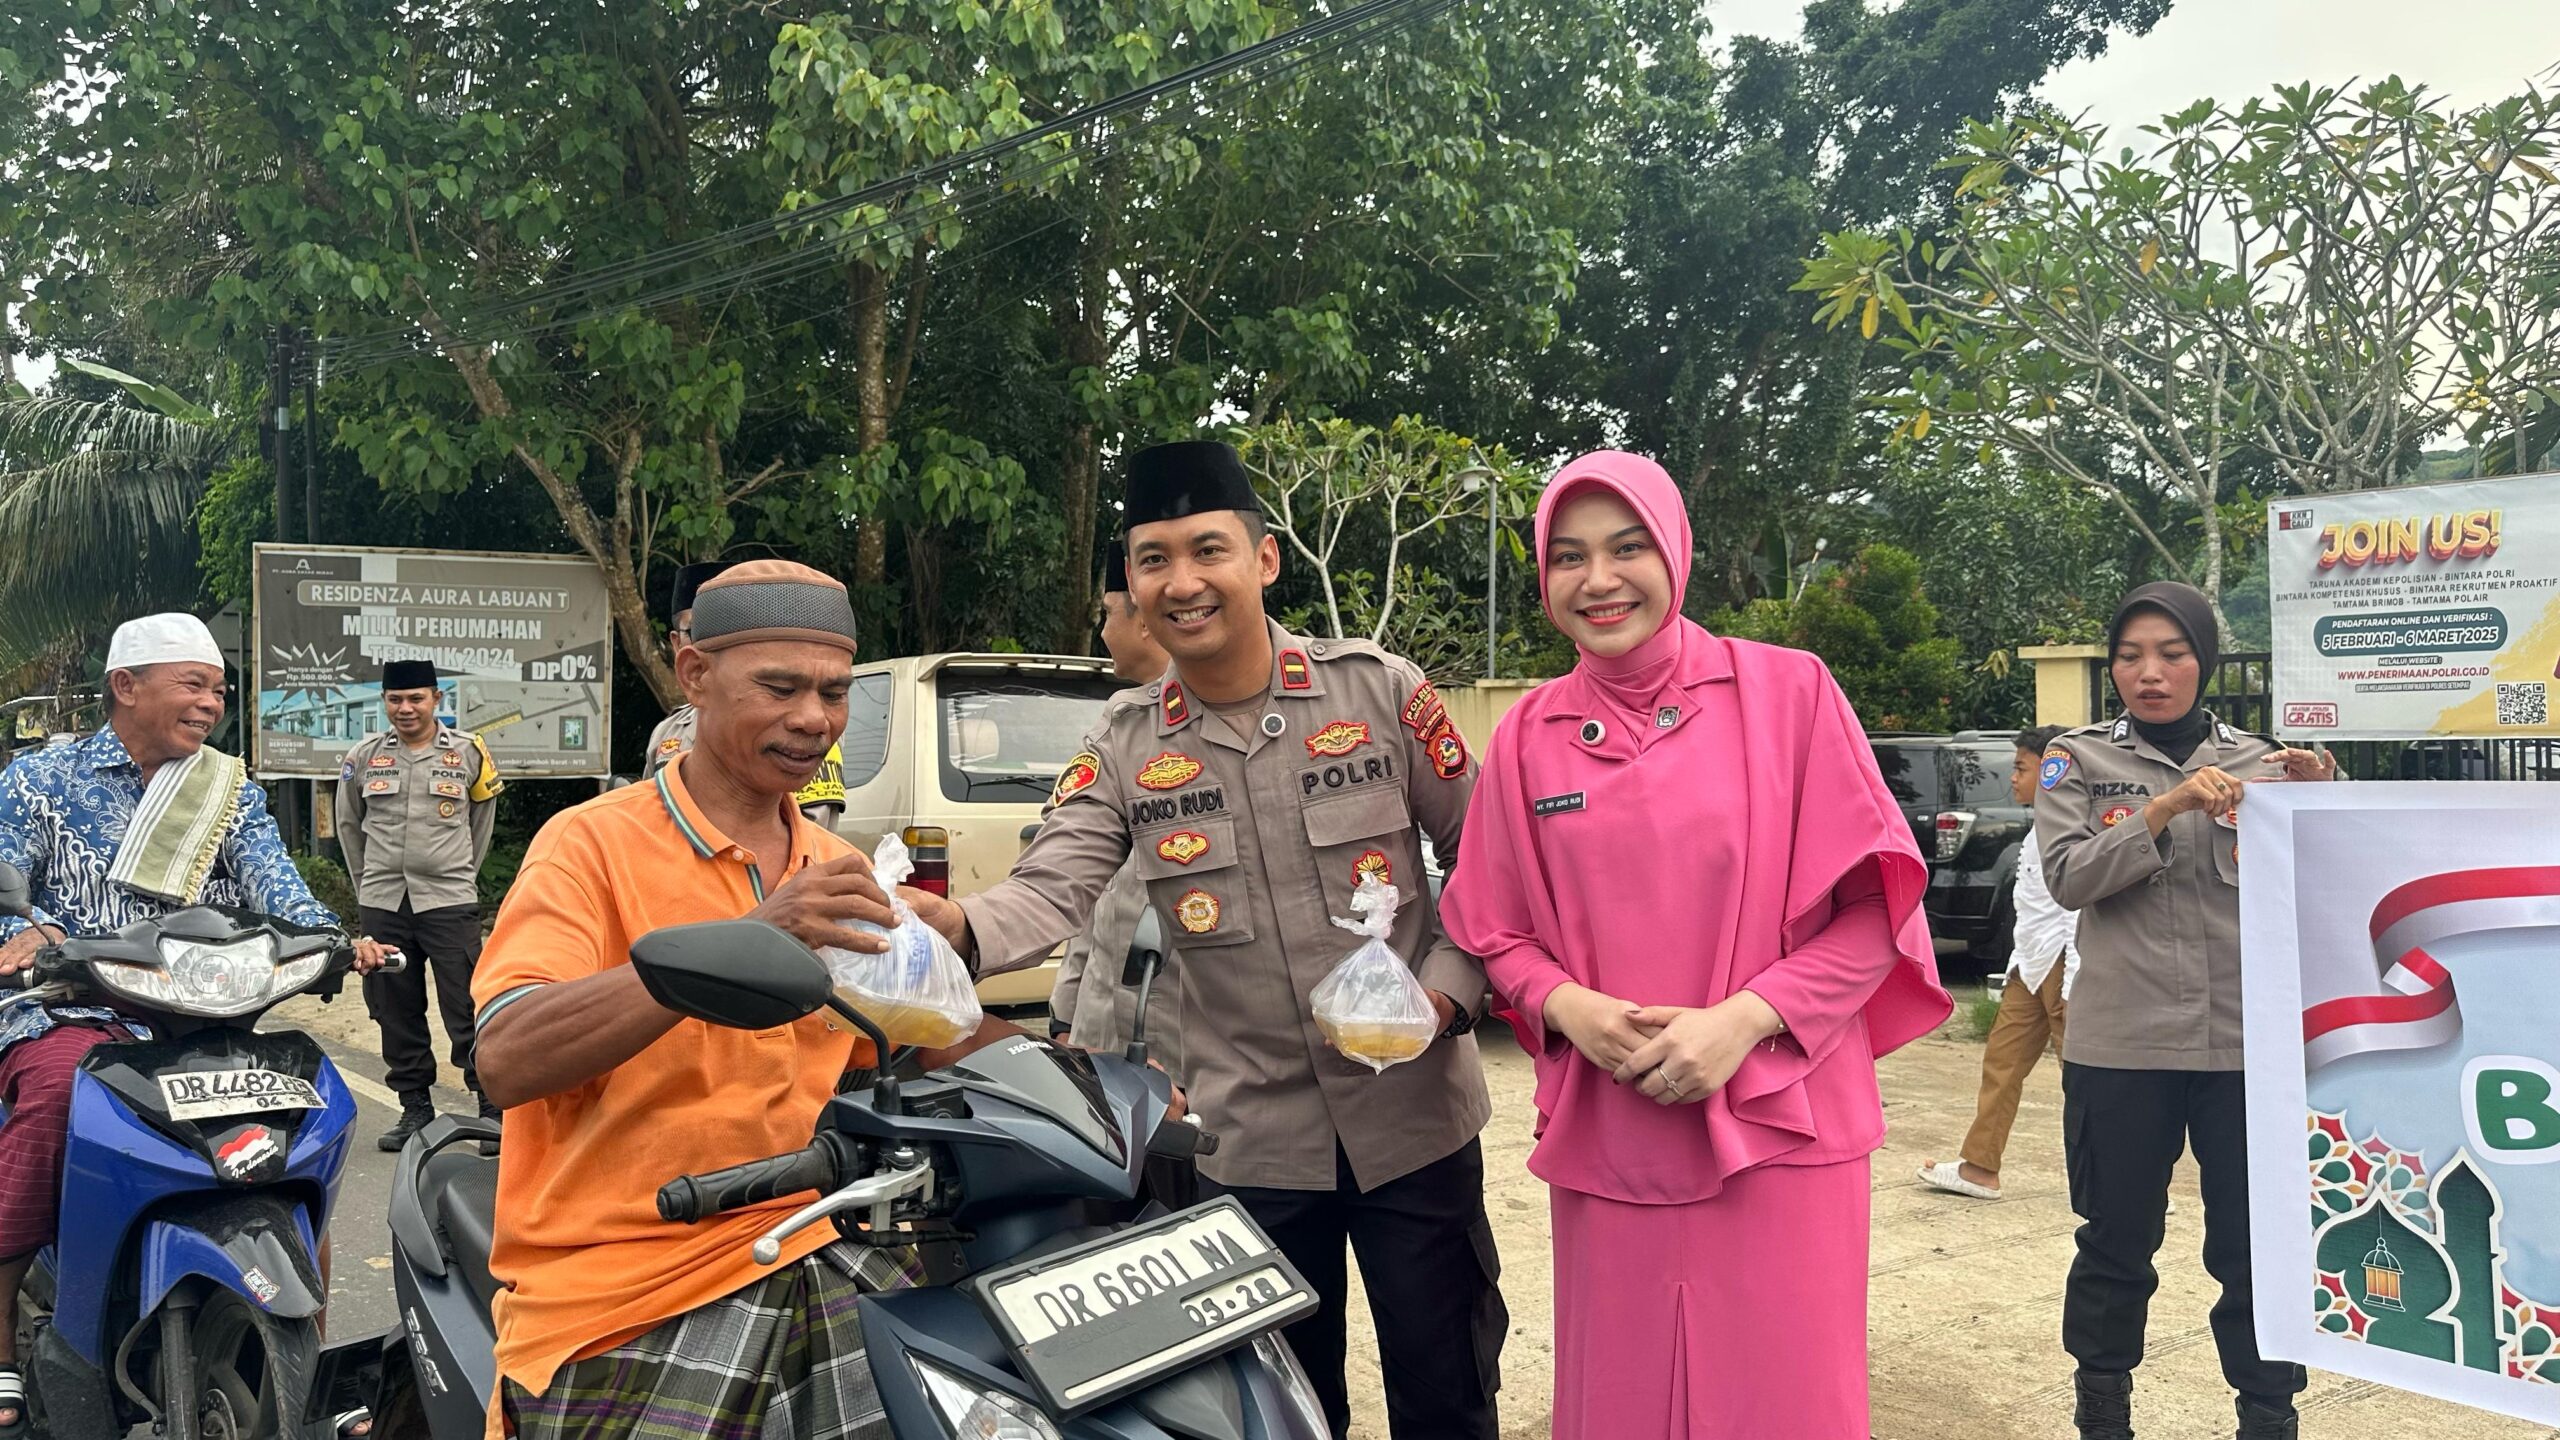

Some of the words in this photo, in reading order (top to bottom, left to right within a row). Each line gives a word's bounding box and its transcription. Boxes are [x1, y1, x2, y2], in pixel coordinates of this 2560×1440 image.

[2319, 516, 2421, 568] JOIN
[2428, 509, 2503, 559] US!
[2276, 592, 2308, 602] BINTARA
[2310, 589, 2364, 600] KOMPETENSI
[2366, 587, 2401, 596] KHUSUS
[2409, 584, 2446, 594] BINTARA
[2450, 581, 2507, 591] REKRUTMEN
[2509, 578, 2558, 589] PROAKTIF
[2309, 580, 2341, 589] TARUNA
[2343, 577, 2381, 587] AKADEMI
[2383, 574, 2436, 586] KEPOLISIAN
[2445, 571, 2483, 581] BINTARA
[2486, 569, 2515, 579] POLRI
[311, 585, 414, 604] RESIDENZA
[420, 588, 472, 606] AURA
[479, 590, 552, 608] LABUAN
[558, 593, 568, 608] T
[2333, 599, 2369, 609] TAMTAMA
[2372, 598, 2404, 607] BRIMOB
[2412, 595, 2451, 605] TAMTAMA
[2454, 593, 2488, 603] POLAIR
[343, 615, 410, 637] MILIKI
[415, 617, 542, 640] PERUMAHAN
[2332, 618, 2389, 629] PENDAFTARAN
[2391, 615, 2420, 626] ONLINE
[2422, 615, 2440, 625] DAN
[2443, 612, 2488, 623] VERIFIKASI
[2321, 635, 2332, 650] 5
[2333, 632, 2395, 649] FEBRUARI
[2405, 631, 2414, 645] 6
[2416, 630, 2463, 644] MARET
[2465, 628, 2498, 642] 2025
[463, 647, 515, 669] 2024
[2338, 667, 2489, 681] WWW.PENERIMAAN.POLRI.GO.ID
[1406, 685, 1431, 720] POLRES
[2288, 712, 2333, 724] GRATIS
[432, 770, 466, 780] POLRI
[1302, 755, 1392, 794] POLRI
[2092, 782, 2150, 798] RIZKA
[1131, 798, 1177, 825] JOKO
[1180, 788, 1224, 816] RUDI
[167, 1074, 210, 1101] DR
[212, 1072, 282, 1096] 4482
[1034, 1283, 1100, 1333] DR
[1093, 1248, 1192, 1311] 6601
